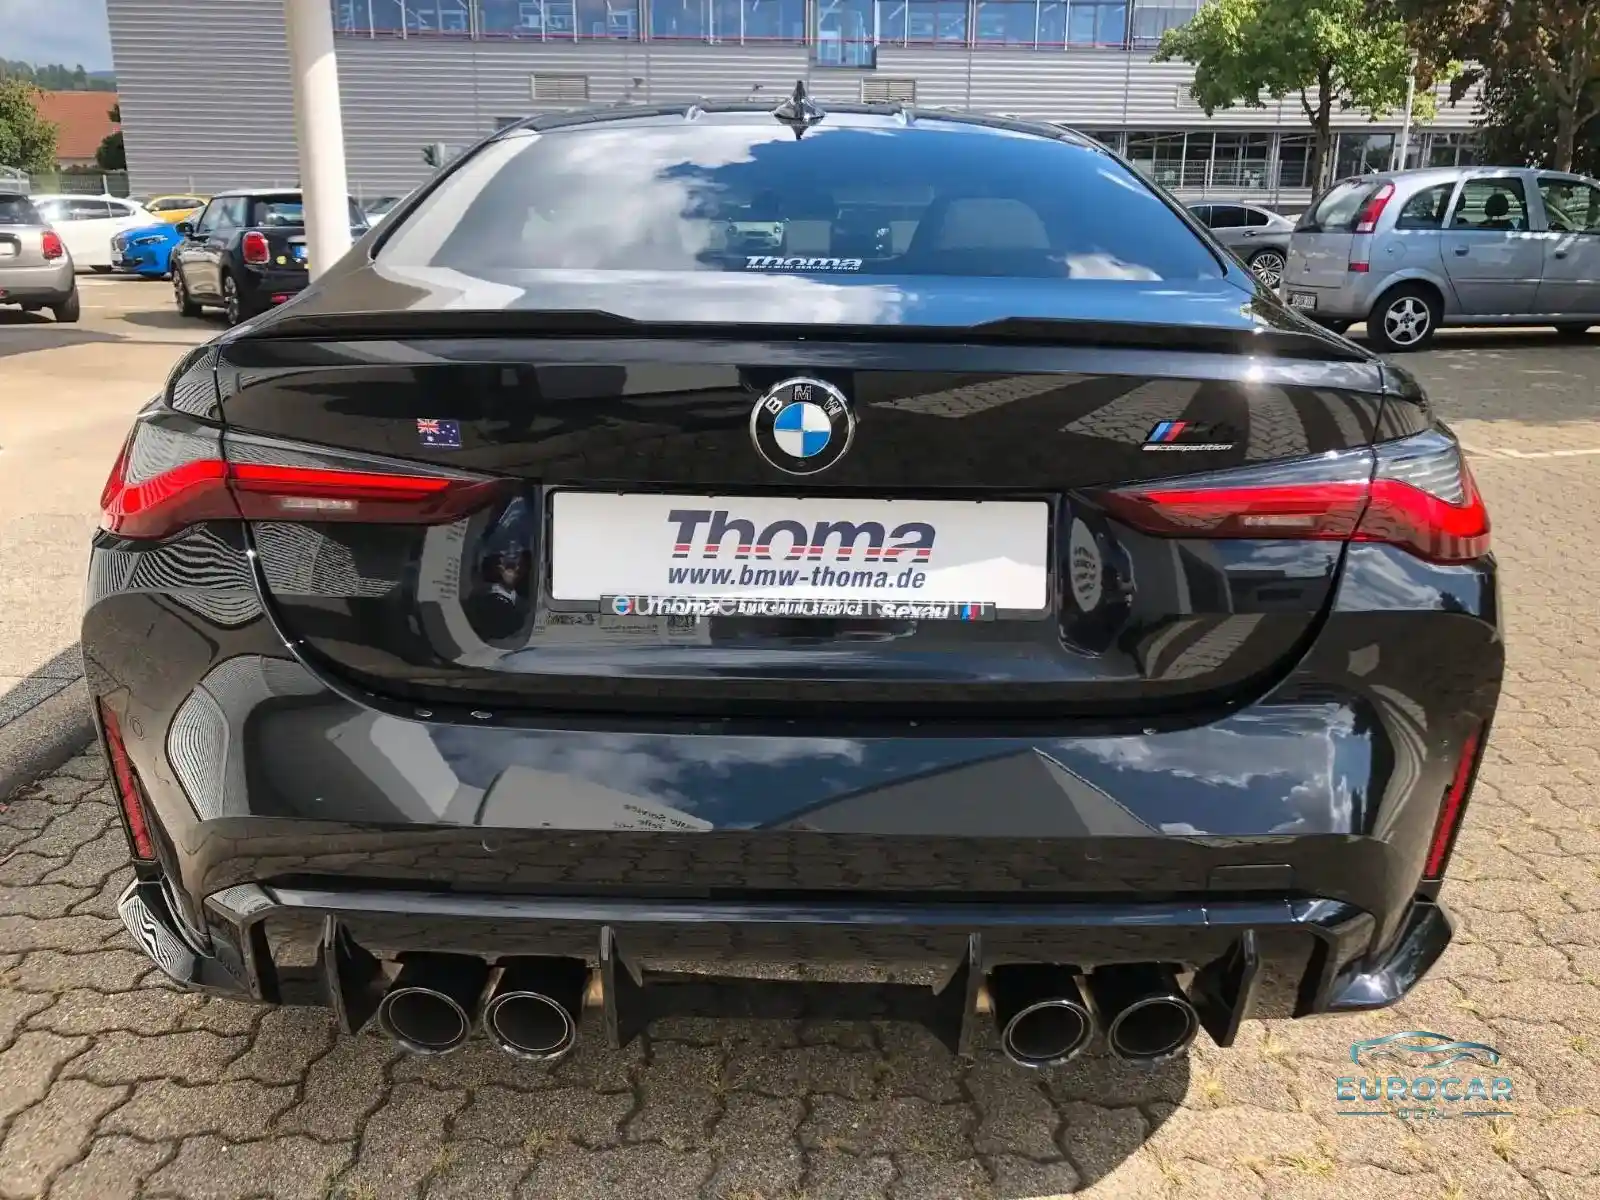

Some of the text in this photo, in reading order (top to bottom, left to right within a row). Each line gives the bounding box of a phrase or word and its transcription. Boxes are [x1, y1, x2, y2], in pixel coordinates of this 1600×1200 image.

[746, 255, 863, 266] Thoma
[764, 385, 843, 417] BMW
[668, 509, 936, 563] Thoma
[668, 565, 926, 589] www.bmw-thoma.de
[811, 603, 863, 616] SERVICE
[880, 603, 949, 619] Sexau
